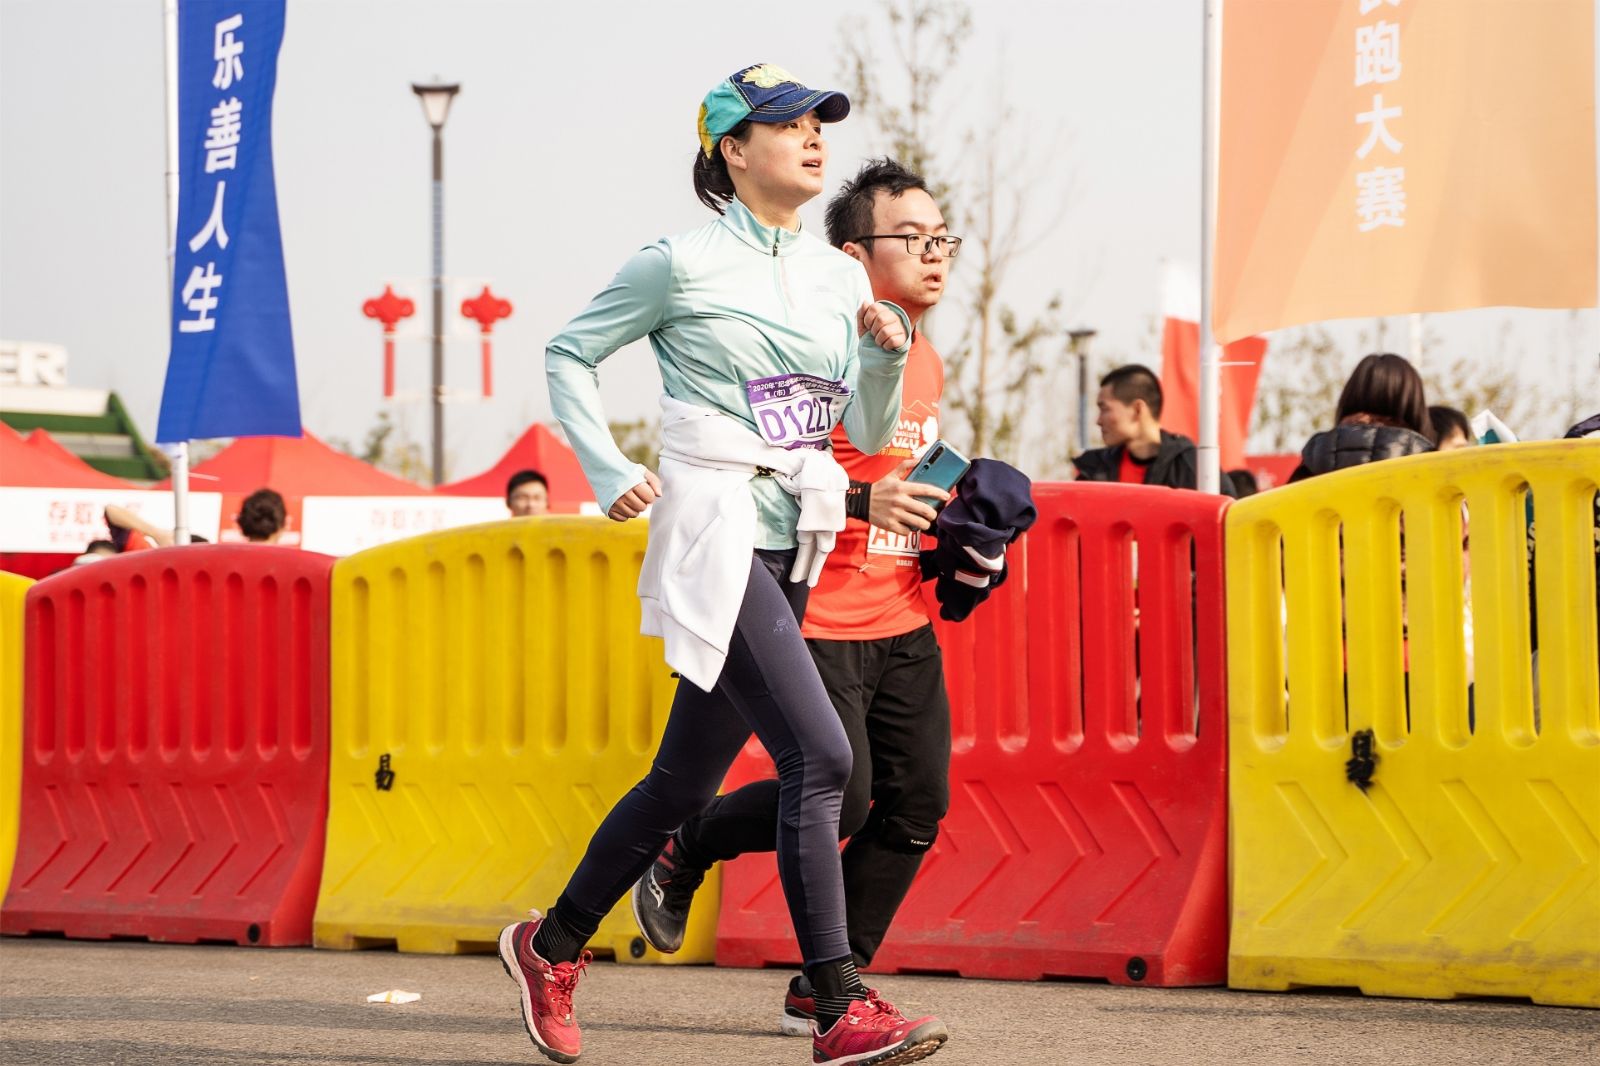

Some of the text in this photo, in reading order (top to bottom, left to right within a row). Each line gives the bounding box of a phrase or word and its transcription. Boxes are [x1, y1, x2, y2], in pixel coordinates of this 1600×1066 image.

[178, 13, 244, 333] 乐善人生
[758, 396, 834, 442] D1227
